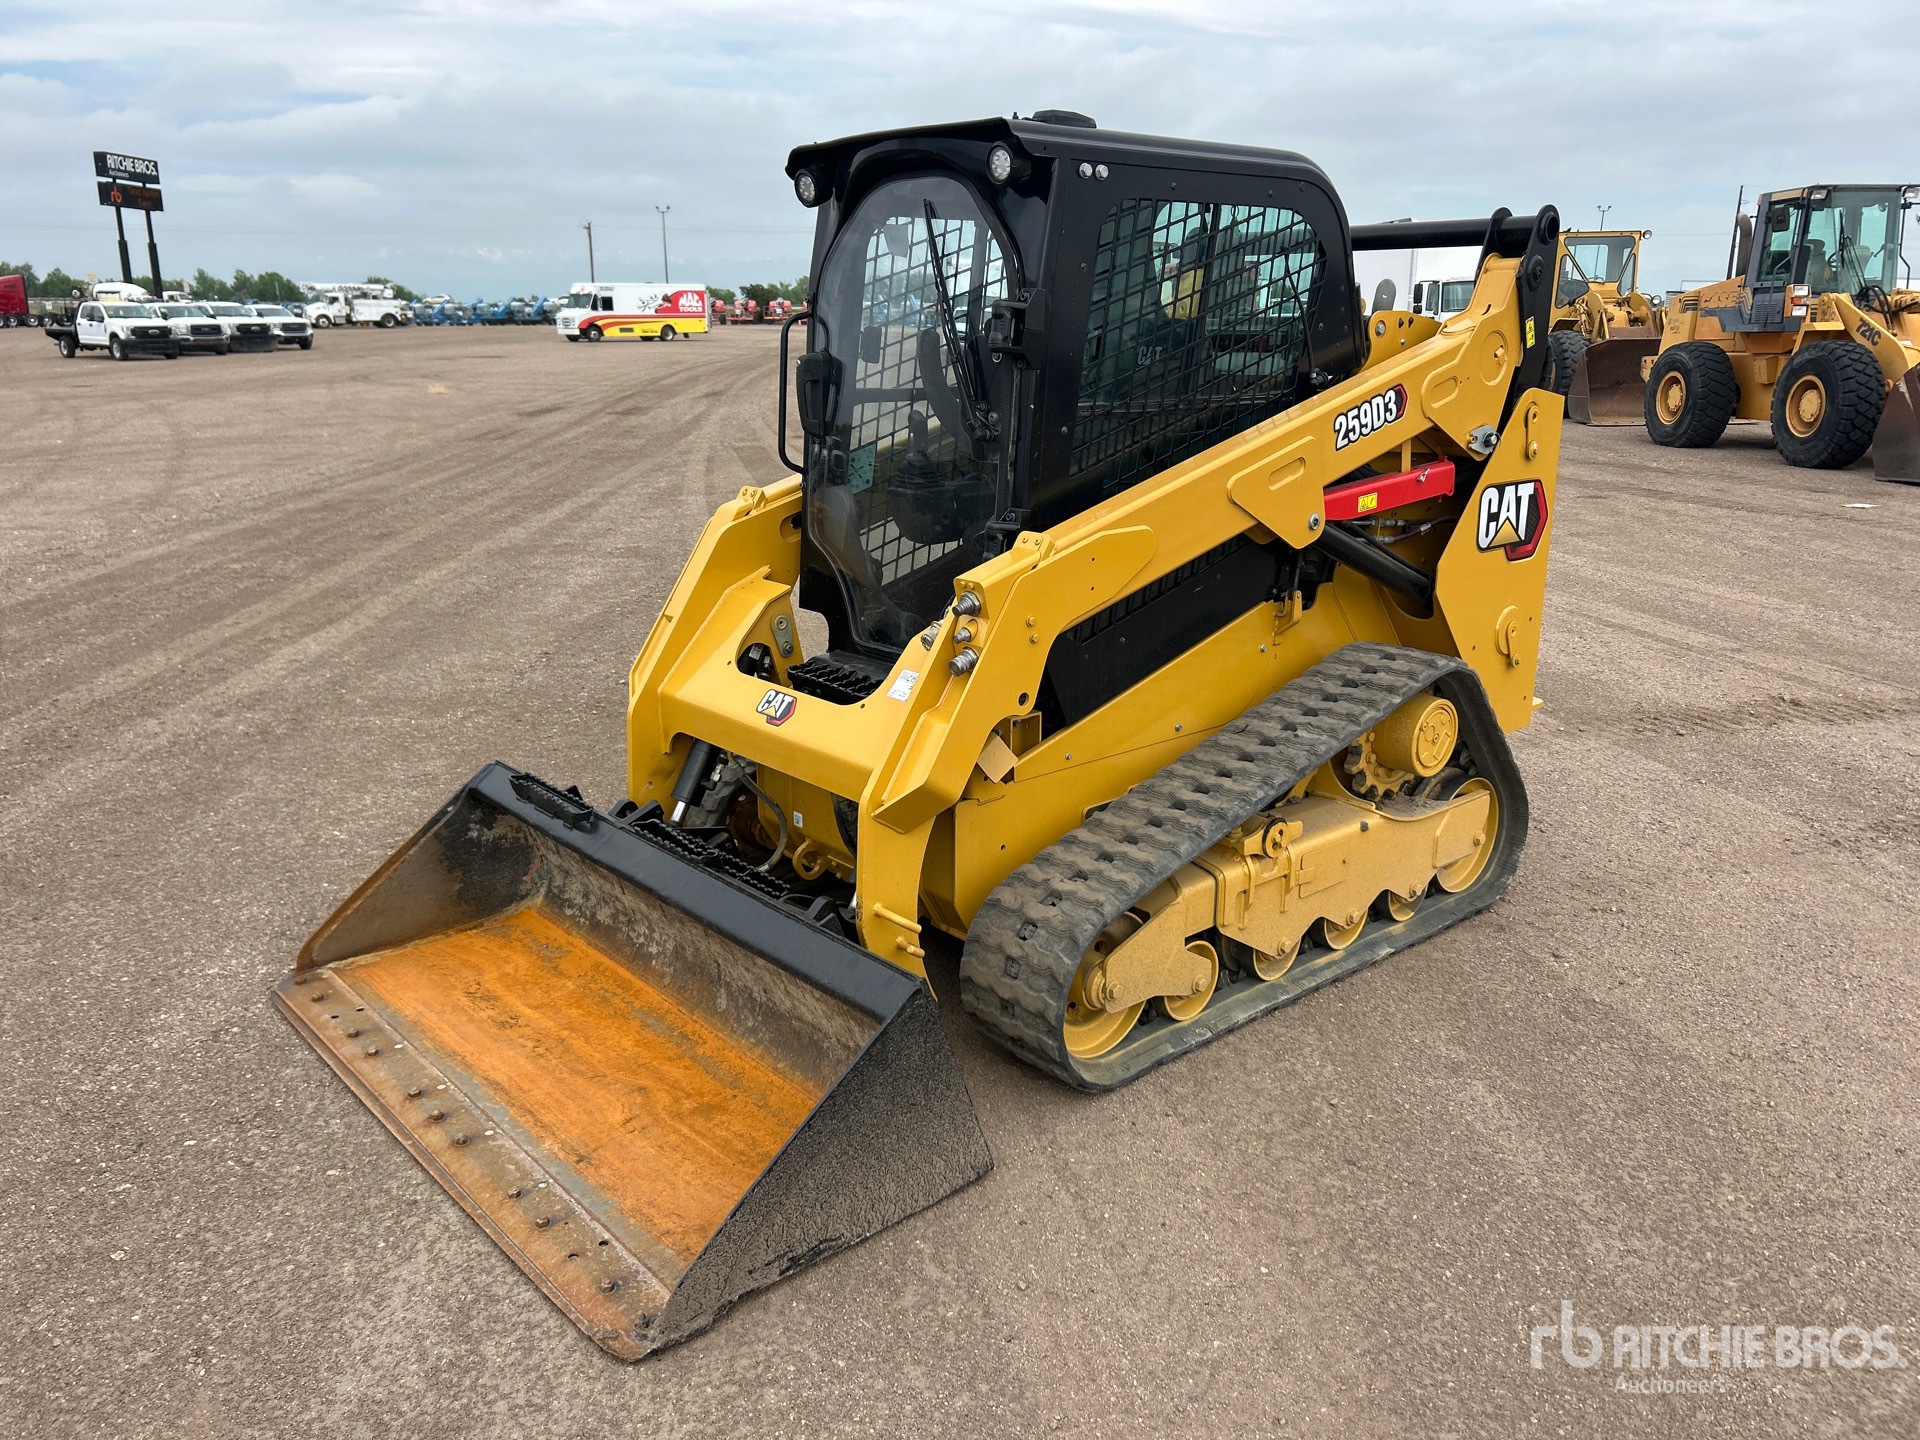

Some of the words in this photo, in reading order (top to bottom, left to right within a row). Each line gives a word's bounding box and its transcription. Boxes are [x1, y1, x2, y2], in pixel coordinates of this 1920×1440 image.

[106, 153, 135, 172] RITCHIE
[134, 158, 158, 176] BROS.
[678, 291, 704, 306] MAC
[1699, 291, 1740, 310] CASE
[1855, 316, 1883, 347] 721C
[1334, 389, 1398, 450] 259D3
[1478, 481, 1536, 549] CAT
[757, 689, 794, 719] CAT
